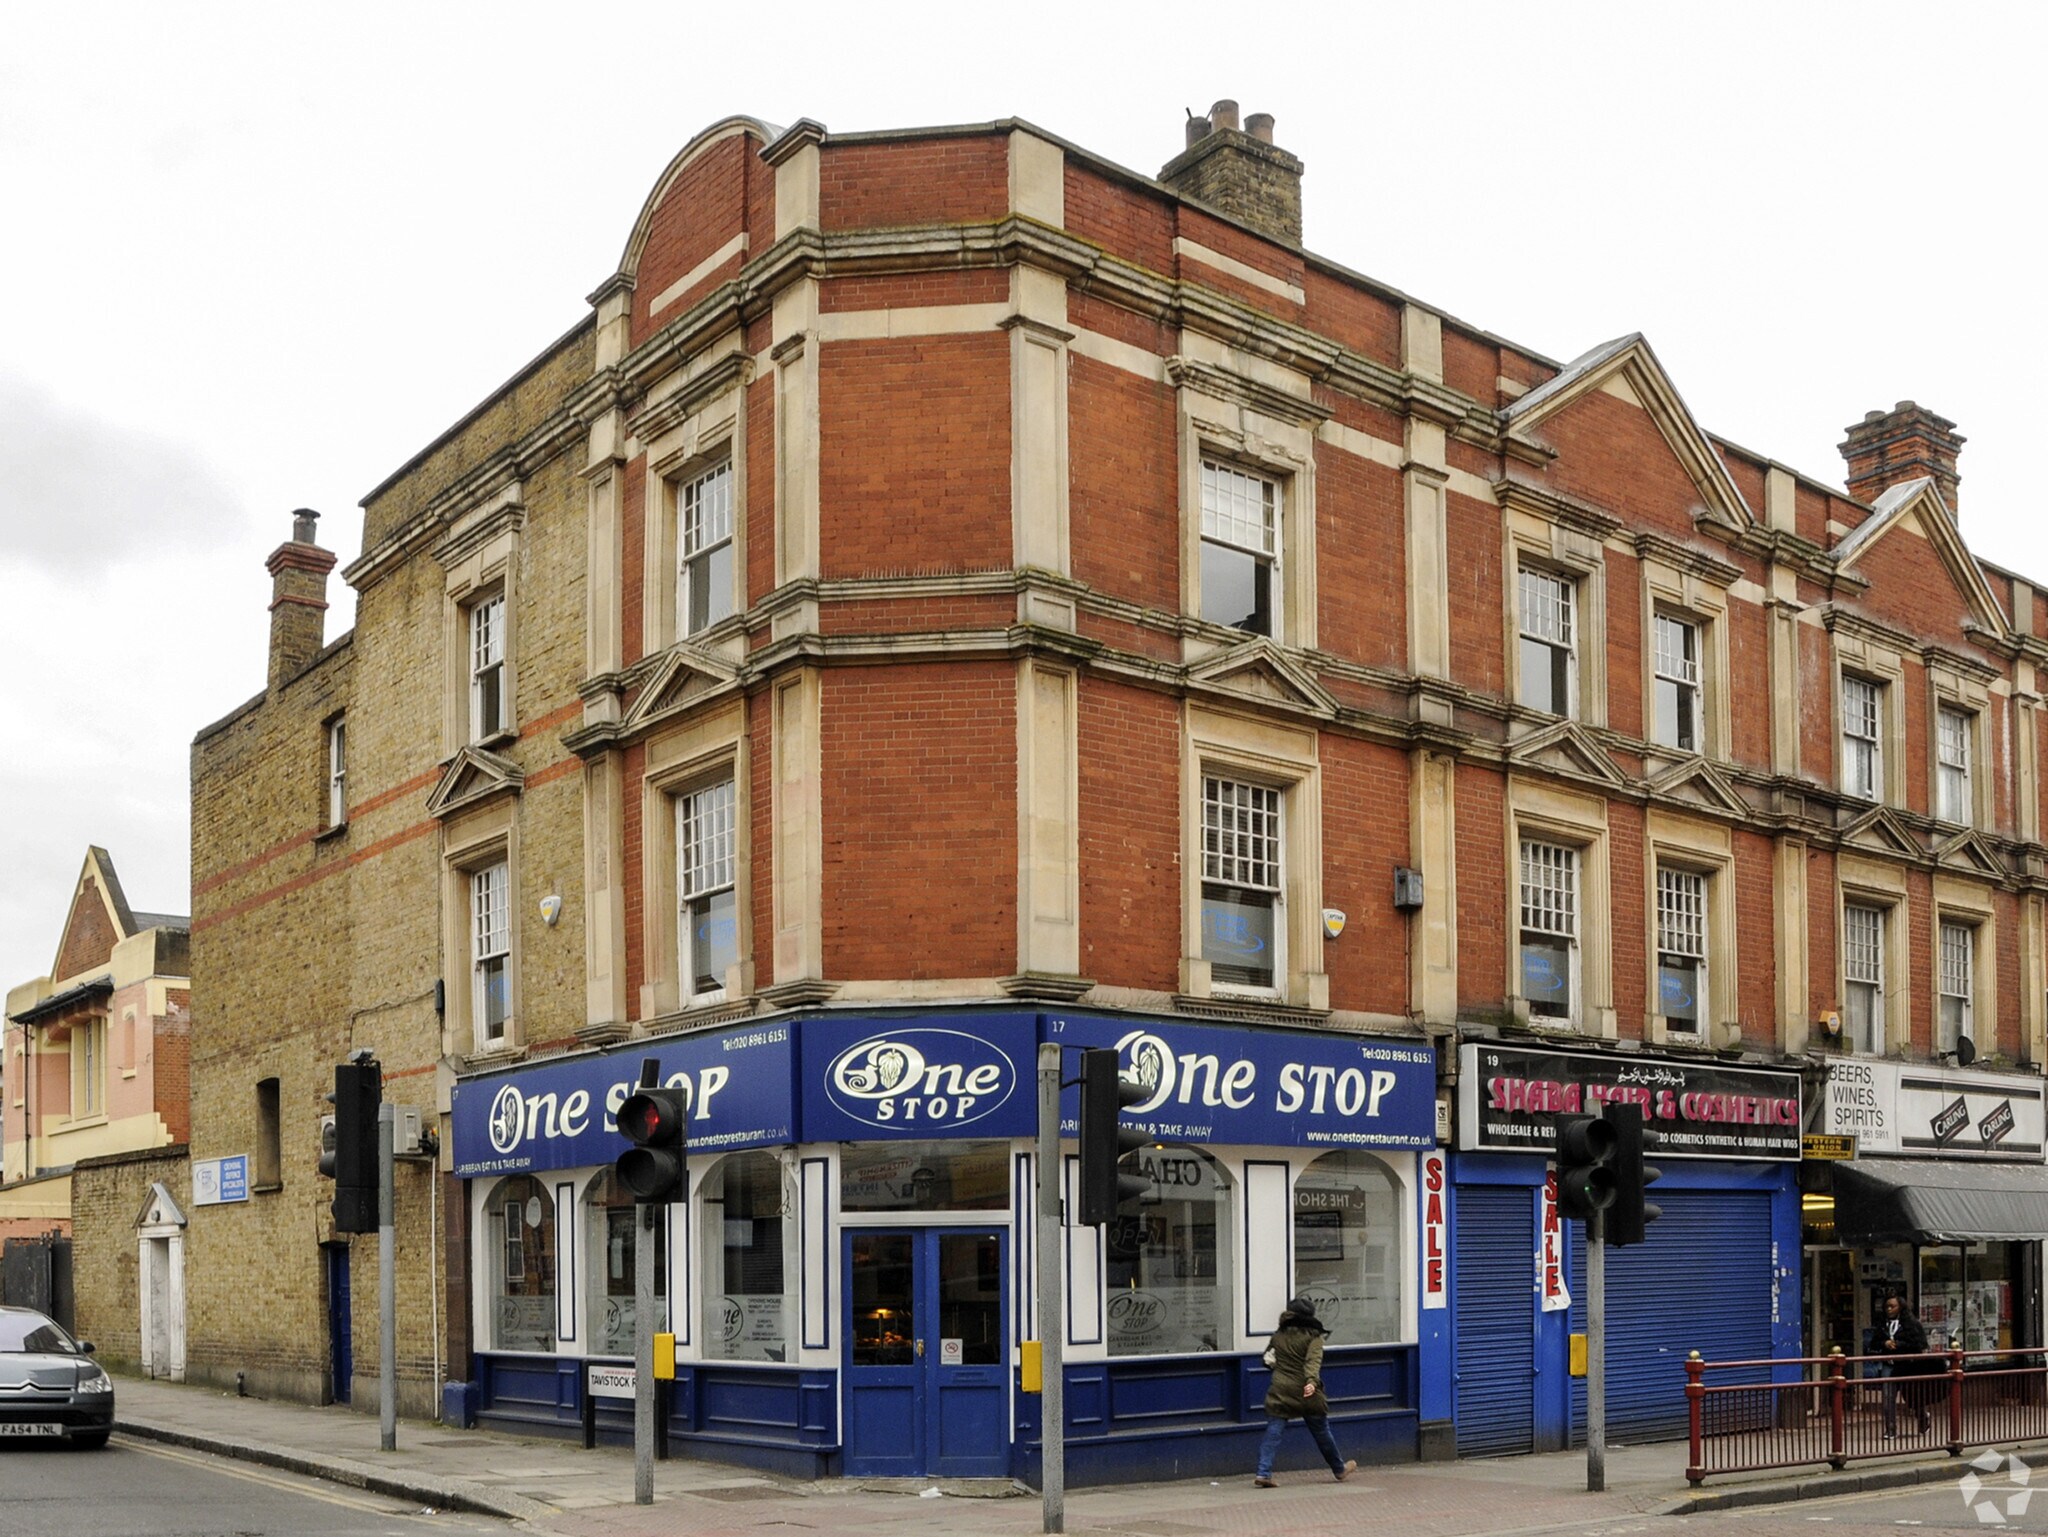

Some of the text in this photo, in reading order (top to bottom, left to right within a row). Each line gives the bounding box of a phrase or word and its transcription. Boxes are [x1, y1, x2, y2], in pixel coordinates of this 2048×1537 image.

[749, 1033, 767, 1047] 8961
[768, 1029, 787, 1043] 6151
[1052, 1021, 1065, 1033] 17
[1391, 1051, 1412, 1062] 8961
[1412, 1053, 1432, 1064] 6151
[1486, 1055, 1499, 1067] 19
[834, 1040, 1000, 1099] One
[1114, 1030, 1396, 1117] One STOP
[1829, 1063, 1875, 1088] BEERS,
[1487, 1076, 1581, 1114] SHABA
[1656, 1089, 1677, 1120] &
[1680, 1092, 1799, 1126] COSMETICS
[1833, 1085, 1877, 1109] WINES,
[489, 1066, 730, 1154] One SOP
[877, 1096, 976, 1121] STOP
[1835, 1107, 1884, 1128] SPIRITS
[1148, 1123, 1157, 1135] &
[1158, 1123, 1183, 1137] TAKE
[1184, 1125, 1213, 1138] AWAY
[1487, 1122, 1532, 1137] WHOLESALE
[1533, 1126, 1540, 1138] &
[1934, 1105, 1967, 1137] CARLING
[1981, 1108, 2012, 1140] CARLING
[1306, 1131, 1433, 1146] www.onestoprestaurant.co.uk
[1669, 1132, 1704, 1145] COSMETICS
[1704, 1133, 1737, 1147] SYNTHETIC
[1737, 1136, 1744, 1147] &
[1744, 1136, 1766, 1148] HUMAN
[1767, 1137, 1782, 1149] HAIR
[1782, 1138, 1799, 1149] WIGS
[1426, 1157, 1443, 1293] SALE
[1545, 1169, 1561, 1297] SALE
[1109, 1296, 1158, 1319] One
[1123, 1317, 1149, 1329] STOP
[591, 1375, 630, 1387] TAVISTOCK
[1, 1424, 56, 1434] FA54 TNL
